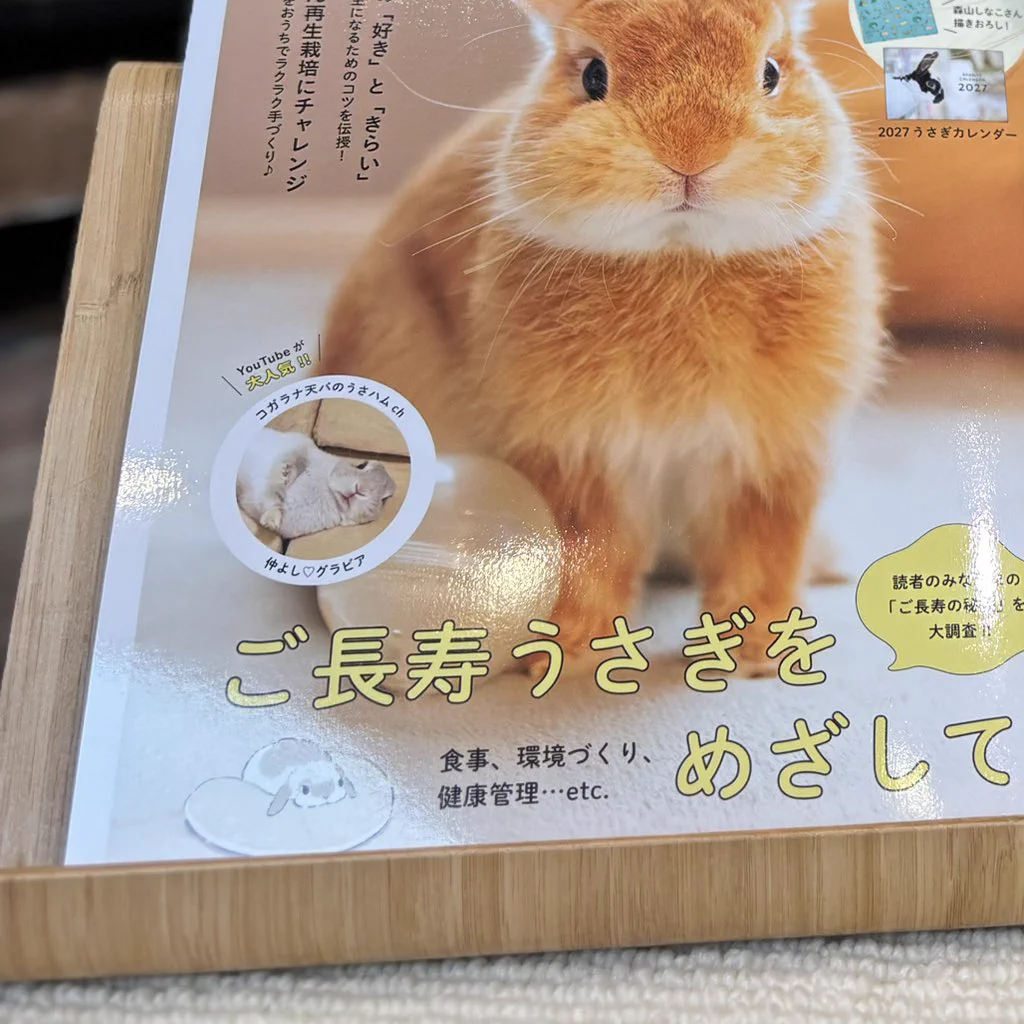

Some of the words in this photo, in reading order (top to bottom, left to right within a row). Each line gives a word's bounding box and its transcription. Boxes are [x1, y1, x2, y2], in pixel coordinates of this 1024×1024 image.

[952, 5, 1024, 20] 森山しなこさん
[958, 83, 988, 93] 2027
[892, 573, 1021, 590] 読者のみなの
[226, 605, 837, 710] ご長寿うさぎを
[439, 742, 653, 774] 食事、環境づくり、
[675, 711, 1013, 800] めざして
